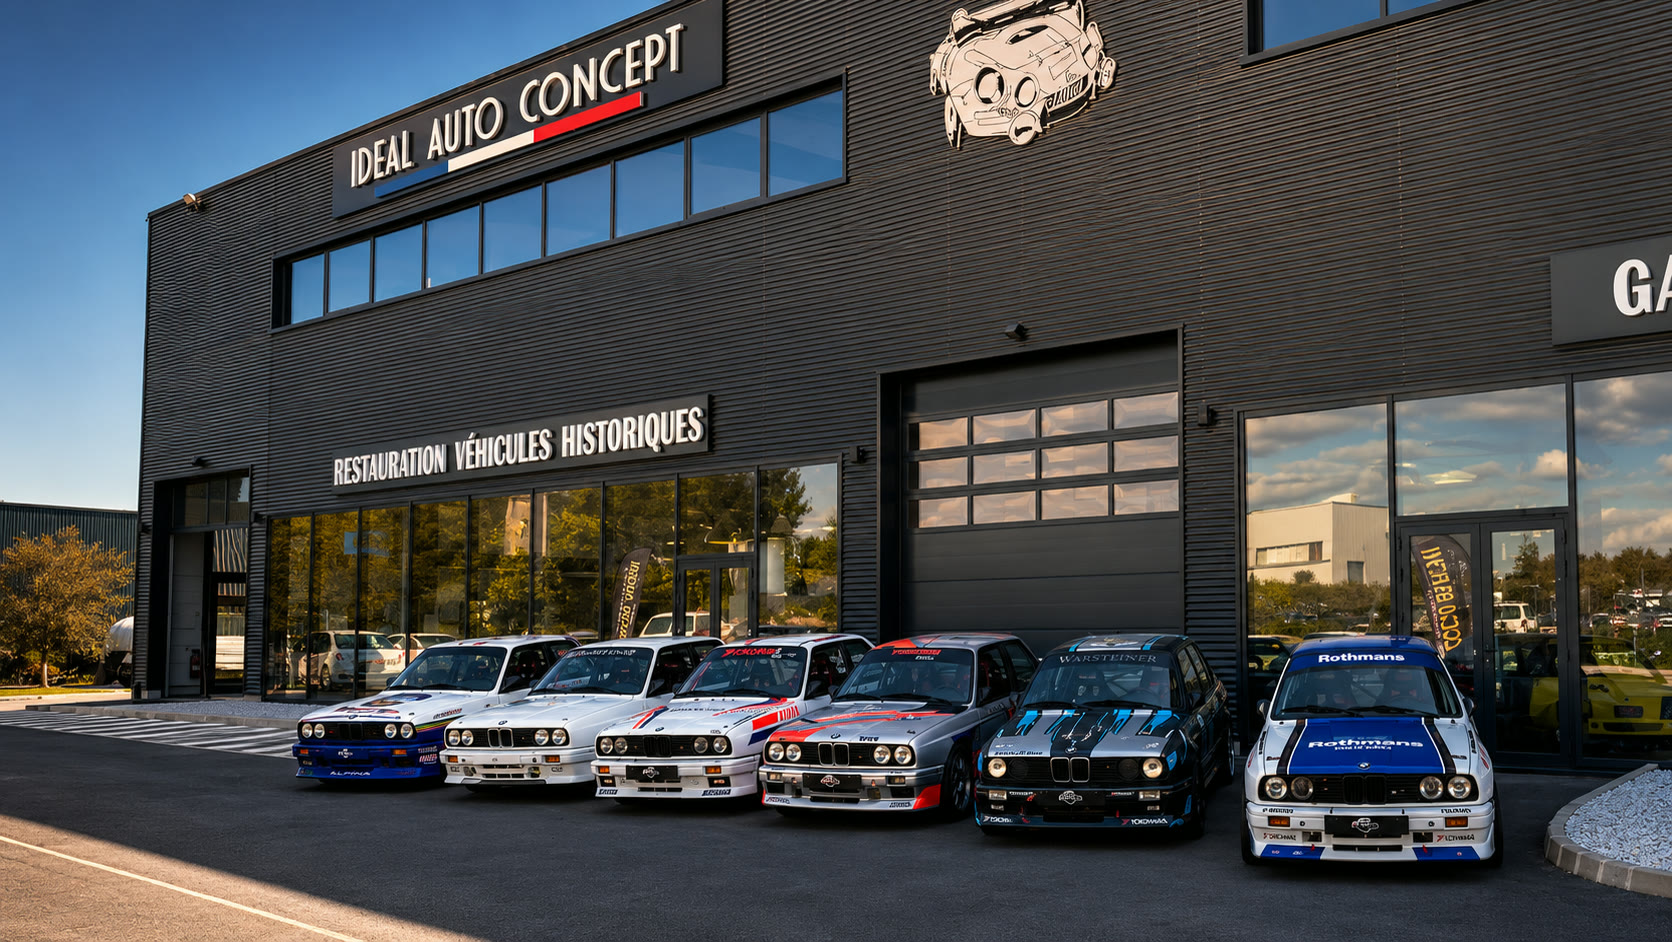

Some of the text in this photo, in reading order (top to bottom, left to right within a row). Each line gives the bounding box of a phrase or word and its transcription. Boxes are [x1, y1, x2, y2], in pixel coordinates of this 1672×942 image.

[351, 23, 685, 188] IDEAL AUTO CONCEPT
[333, 406, 704, 486] RESTAURATION VÉHICULES HISTORIQUES
[1060, 652, 1157, 663] WARSTEINER
[1318, 653, 1405, 663] Rothmans
[1308, 739, 1424, 748] Rothmans
